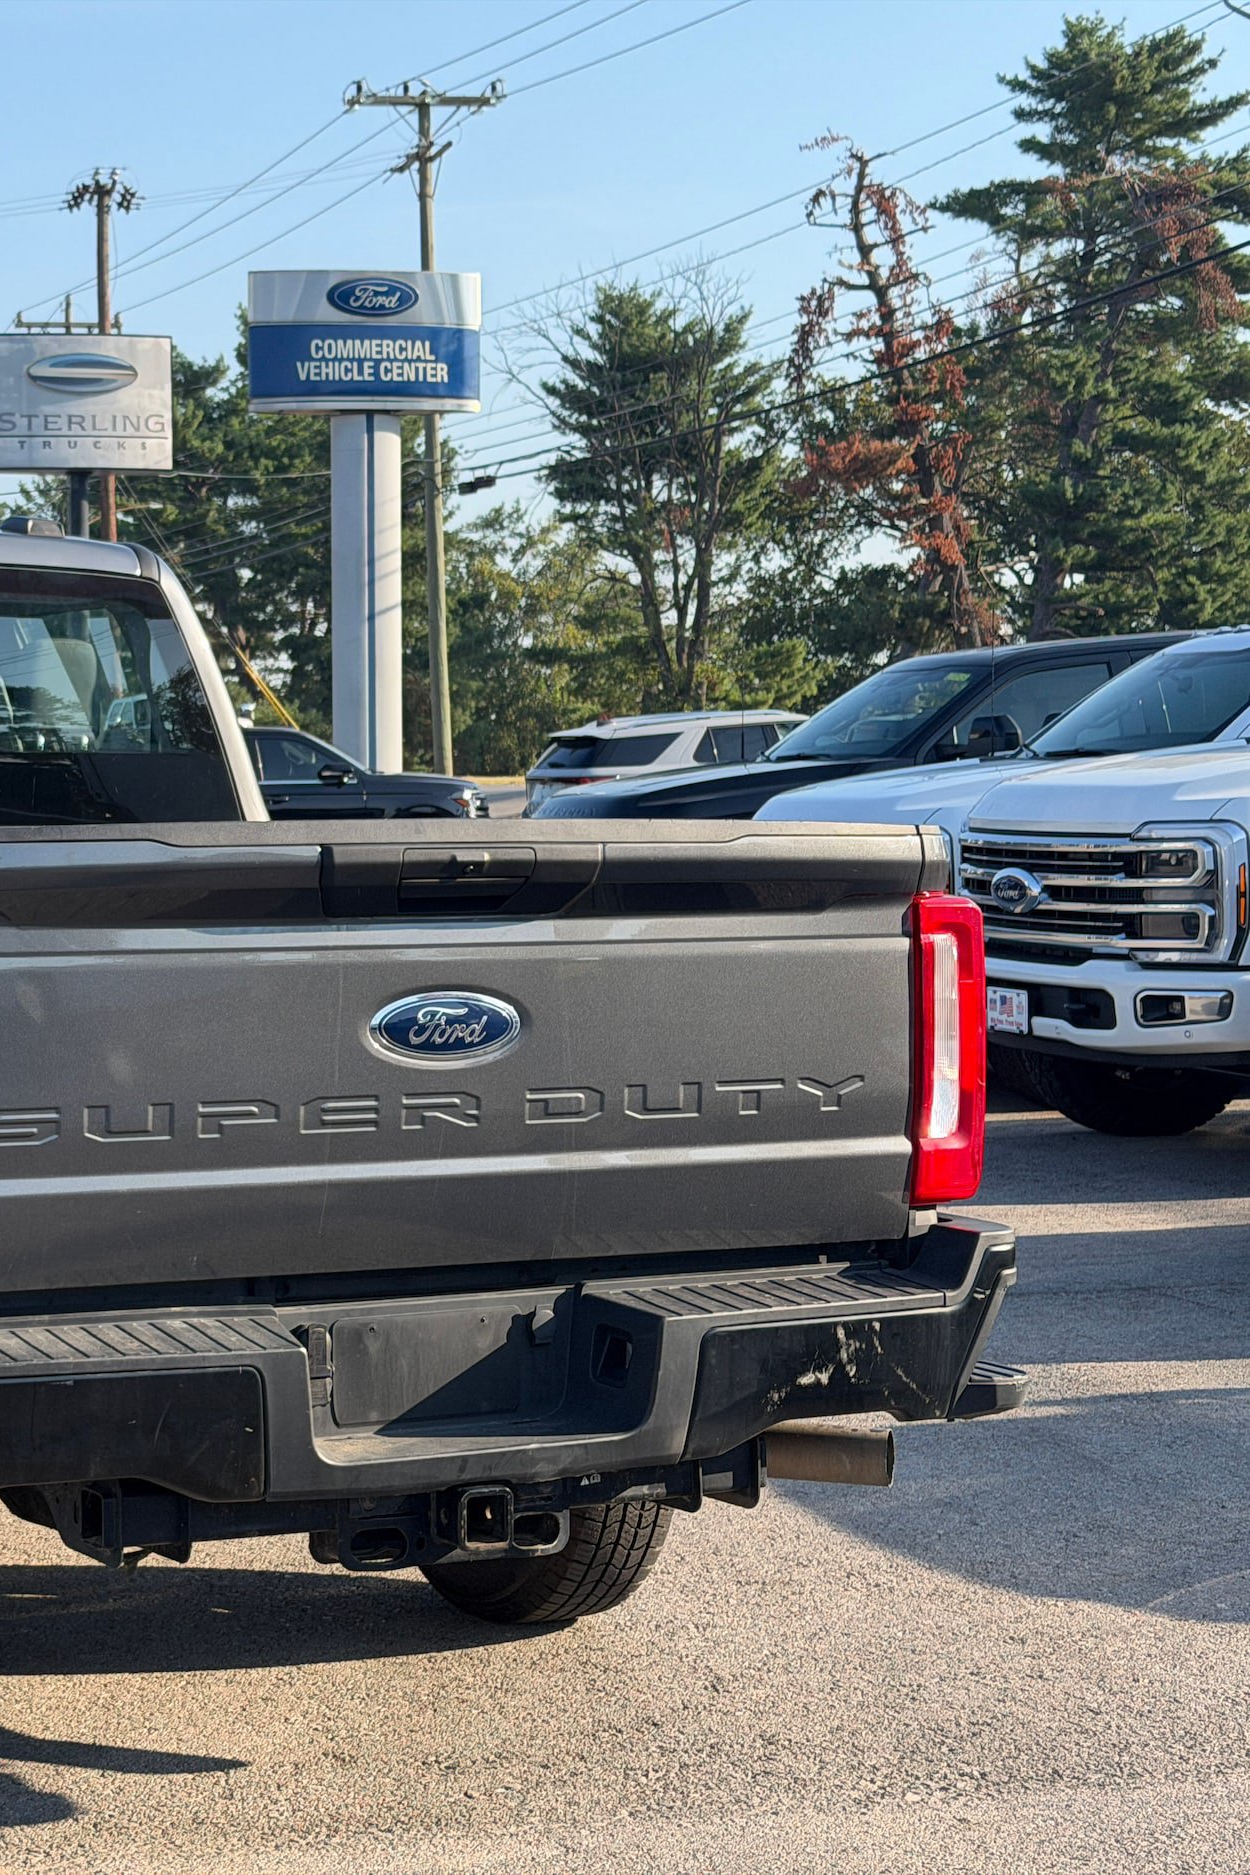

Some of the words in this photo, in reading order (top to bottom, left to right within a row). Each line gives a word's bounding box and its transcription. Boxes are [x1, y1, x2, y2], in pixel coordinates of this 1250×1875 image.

[349, 284, 401, 309] Ford
[310, 338, 436, 361] COMMERCIAL
[296, 360, 375, 382] VEHICLE
[379, 361, 449, 384] CENTER
[17, 440, 148, 451] TRUCKS
[408, 1006, 488, 1045] Ford
[525, 1075, 865, 1124] DUTY
